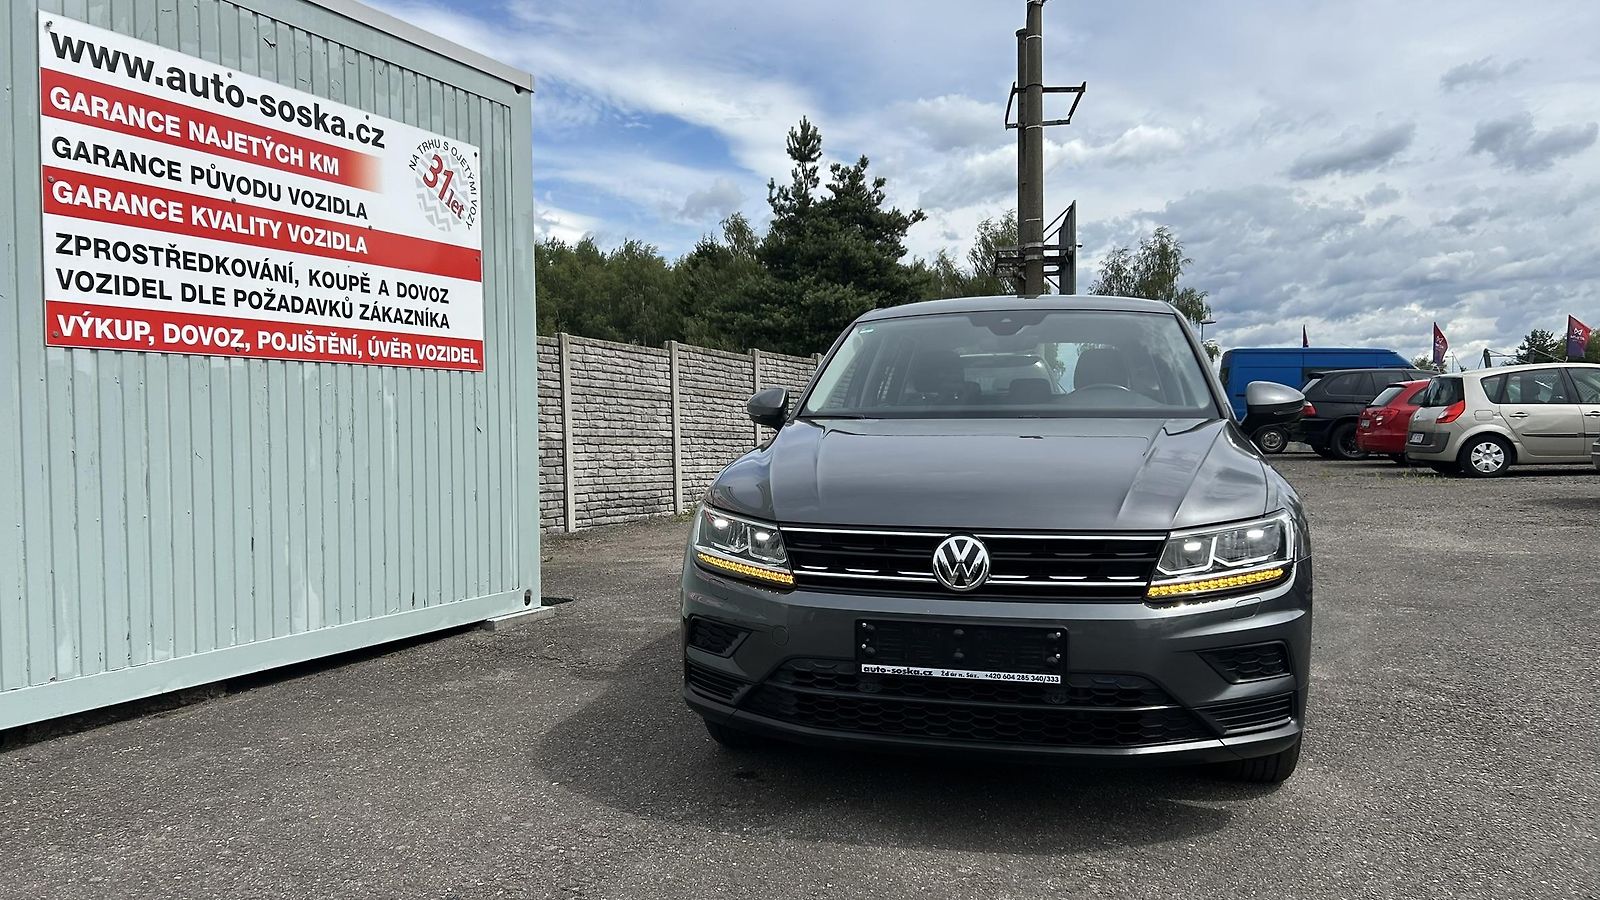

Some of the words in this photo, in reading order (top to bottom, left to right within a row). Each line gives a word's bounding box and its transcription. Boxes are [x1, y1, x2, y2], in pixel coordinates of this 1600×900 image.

[50, 31, 386, 149] www.auto-soska.cz
[50, 86, 181, 138] GARANCE
[188, 120, 303, 168] NAJETÝCH
[309, 151, 340, 176] KM
[52, 136, 182, 182] GARANCE
[190, 163, 281, 202] PŮVODU
[288, 186, 368, 220] VOZIDLA
[408, 153, 420, 171] NA
[416, 138, 441, 155] TRHU
[443, 141, 449, 151] S
[450, 146, 477, 195] OJETÝMI
[466, 199, 478, 231] VOZY
[422, 153, 454, 201] 31
[444, 188, 465, 220] let
[52, 180, 184, 223] GARANCE
[191, 205, 282, 239] KVALITY
[286, 222, 368, 255] VOZIDLA
[55, 232, 299, 288] ZPROSTŘEDKOVÁNÍ,
[308, 268, 371, 294] KOUPĚ
[378, 279, 390, 297] A
[396, 281, 450, 305] DOVOZ
[55, 267, 173, 301] VOZIDEL
[181, 282, 226, 306] DLE
[233, 287, 353, 319] POŽADAVKŮ
[359, 301, 450, 329] ZÁKAZNÍKA
[56, 310, 155, 346] VÝKUP,
[163, 322, 251, 352] DOVOZ,
[257, 329, 363, 359] POJIŠTĚNÍ,
[367, 335, 412, 359] ÚVĚR
[415, 343, 479, 364] VOZIDEL
[863, 665, 933, 677] auto-soska.cz
[984, 672, 1001, 680] +420
[1030, 675, 1059, 684] 340/333
